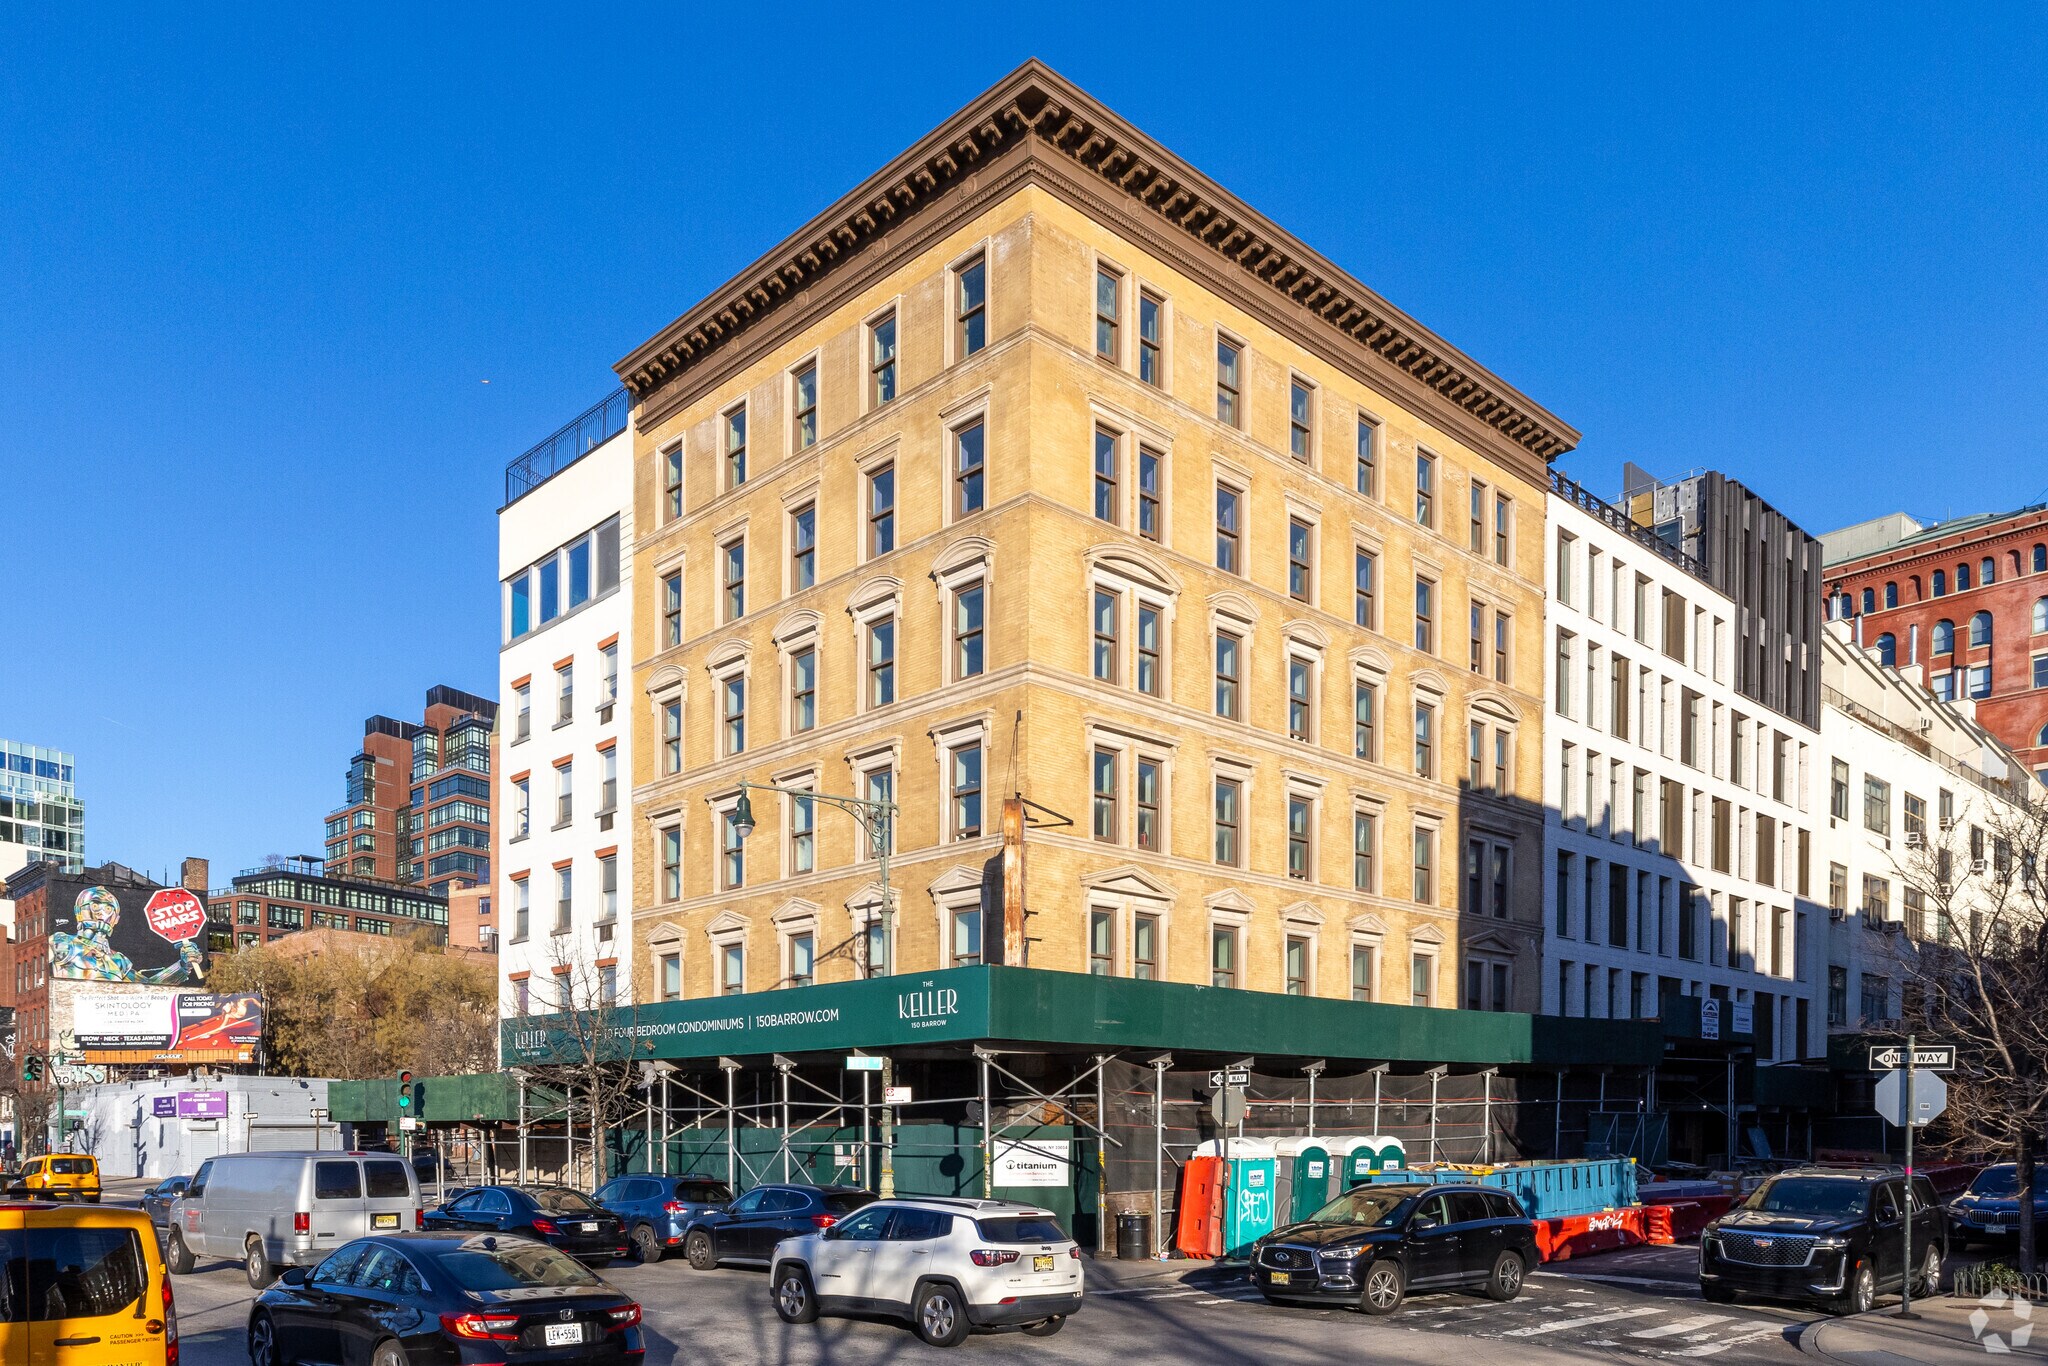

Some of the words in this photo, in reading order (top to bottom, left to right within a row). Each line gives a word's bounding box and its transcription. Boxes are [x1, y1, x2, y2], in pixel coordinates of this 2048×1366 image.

[152, 900, 195, 922] STOP
[154, 910, 200, 931] WARS
[898, 988, 959, 1019] KELLER
[636, 1023, 676, 1037] BEDROOM
[677, 1017, 744, 1034] CONDOMINIUMS
[755, 1008, 839, 1028] 150BARROW.COM
[921, 1019, 947, 1028] BARROW
[1883, 1053, 1906, 1062] ONE
[1917, 1053, 1943, 1062] WAY
[1016, 1161, 1057, 1170] titanium
